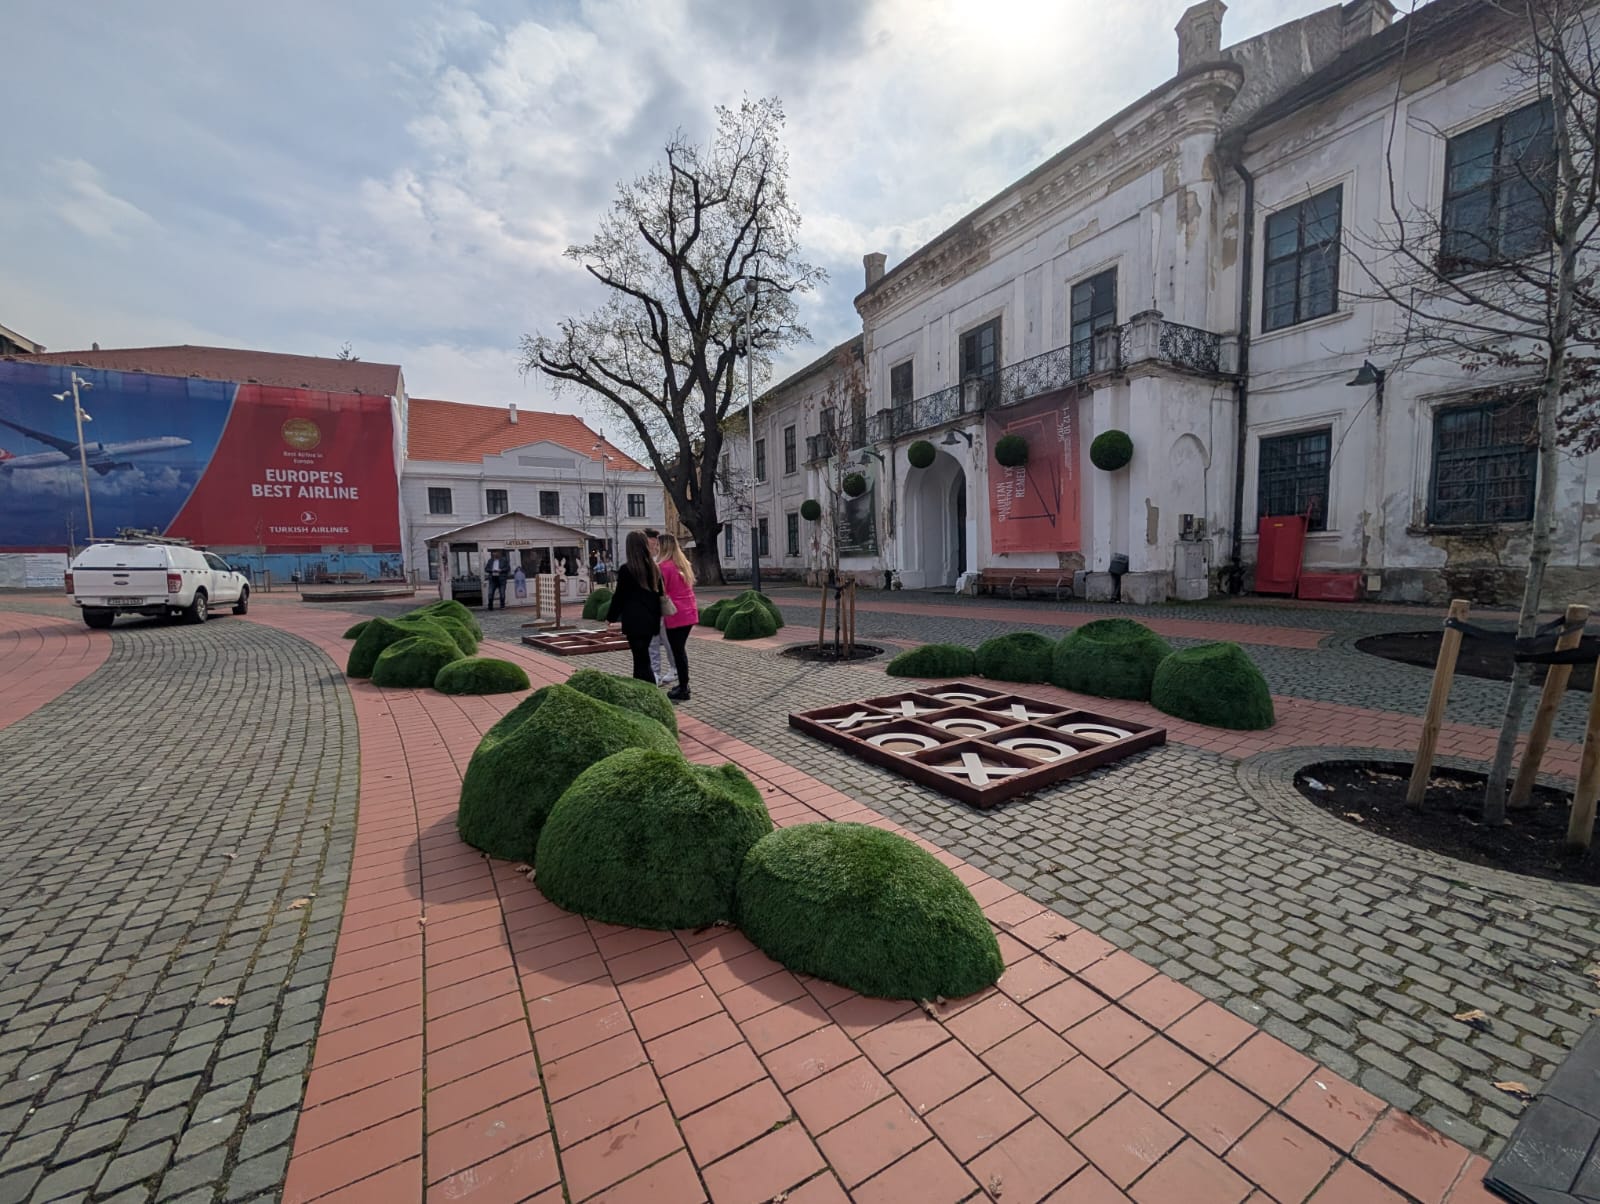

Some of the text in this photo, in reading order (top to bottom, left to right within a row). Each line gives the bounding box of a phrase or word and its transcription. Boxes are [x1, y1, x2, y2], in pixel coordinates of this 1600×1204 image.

[265, 468, 344, 484] EUROPE'S
[251, 484, 359, 500] BEST AIRLINE
